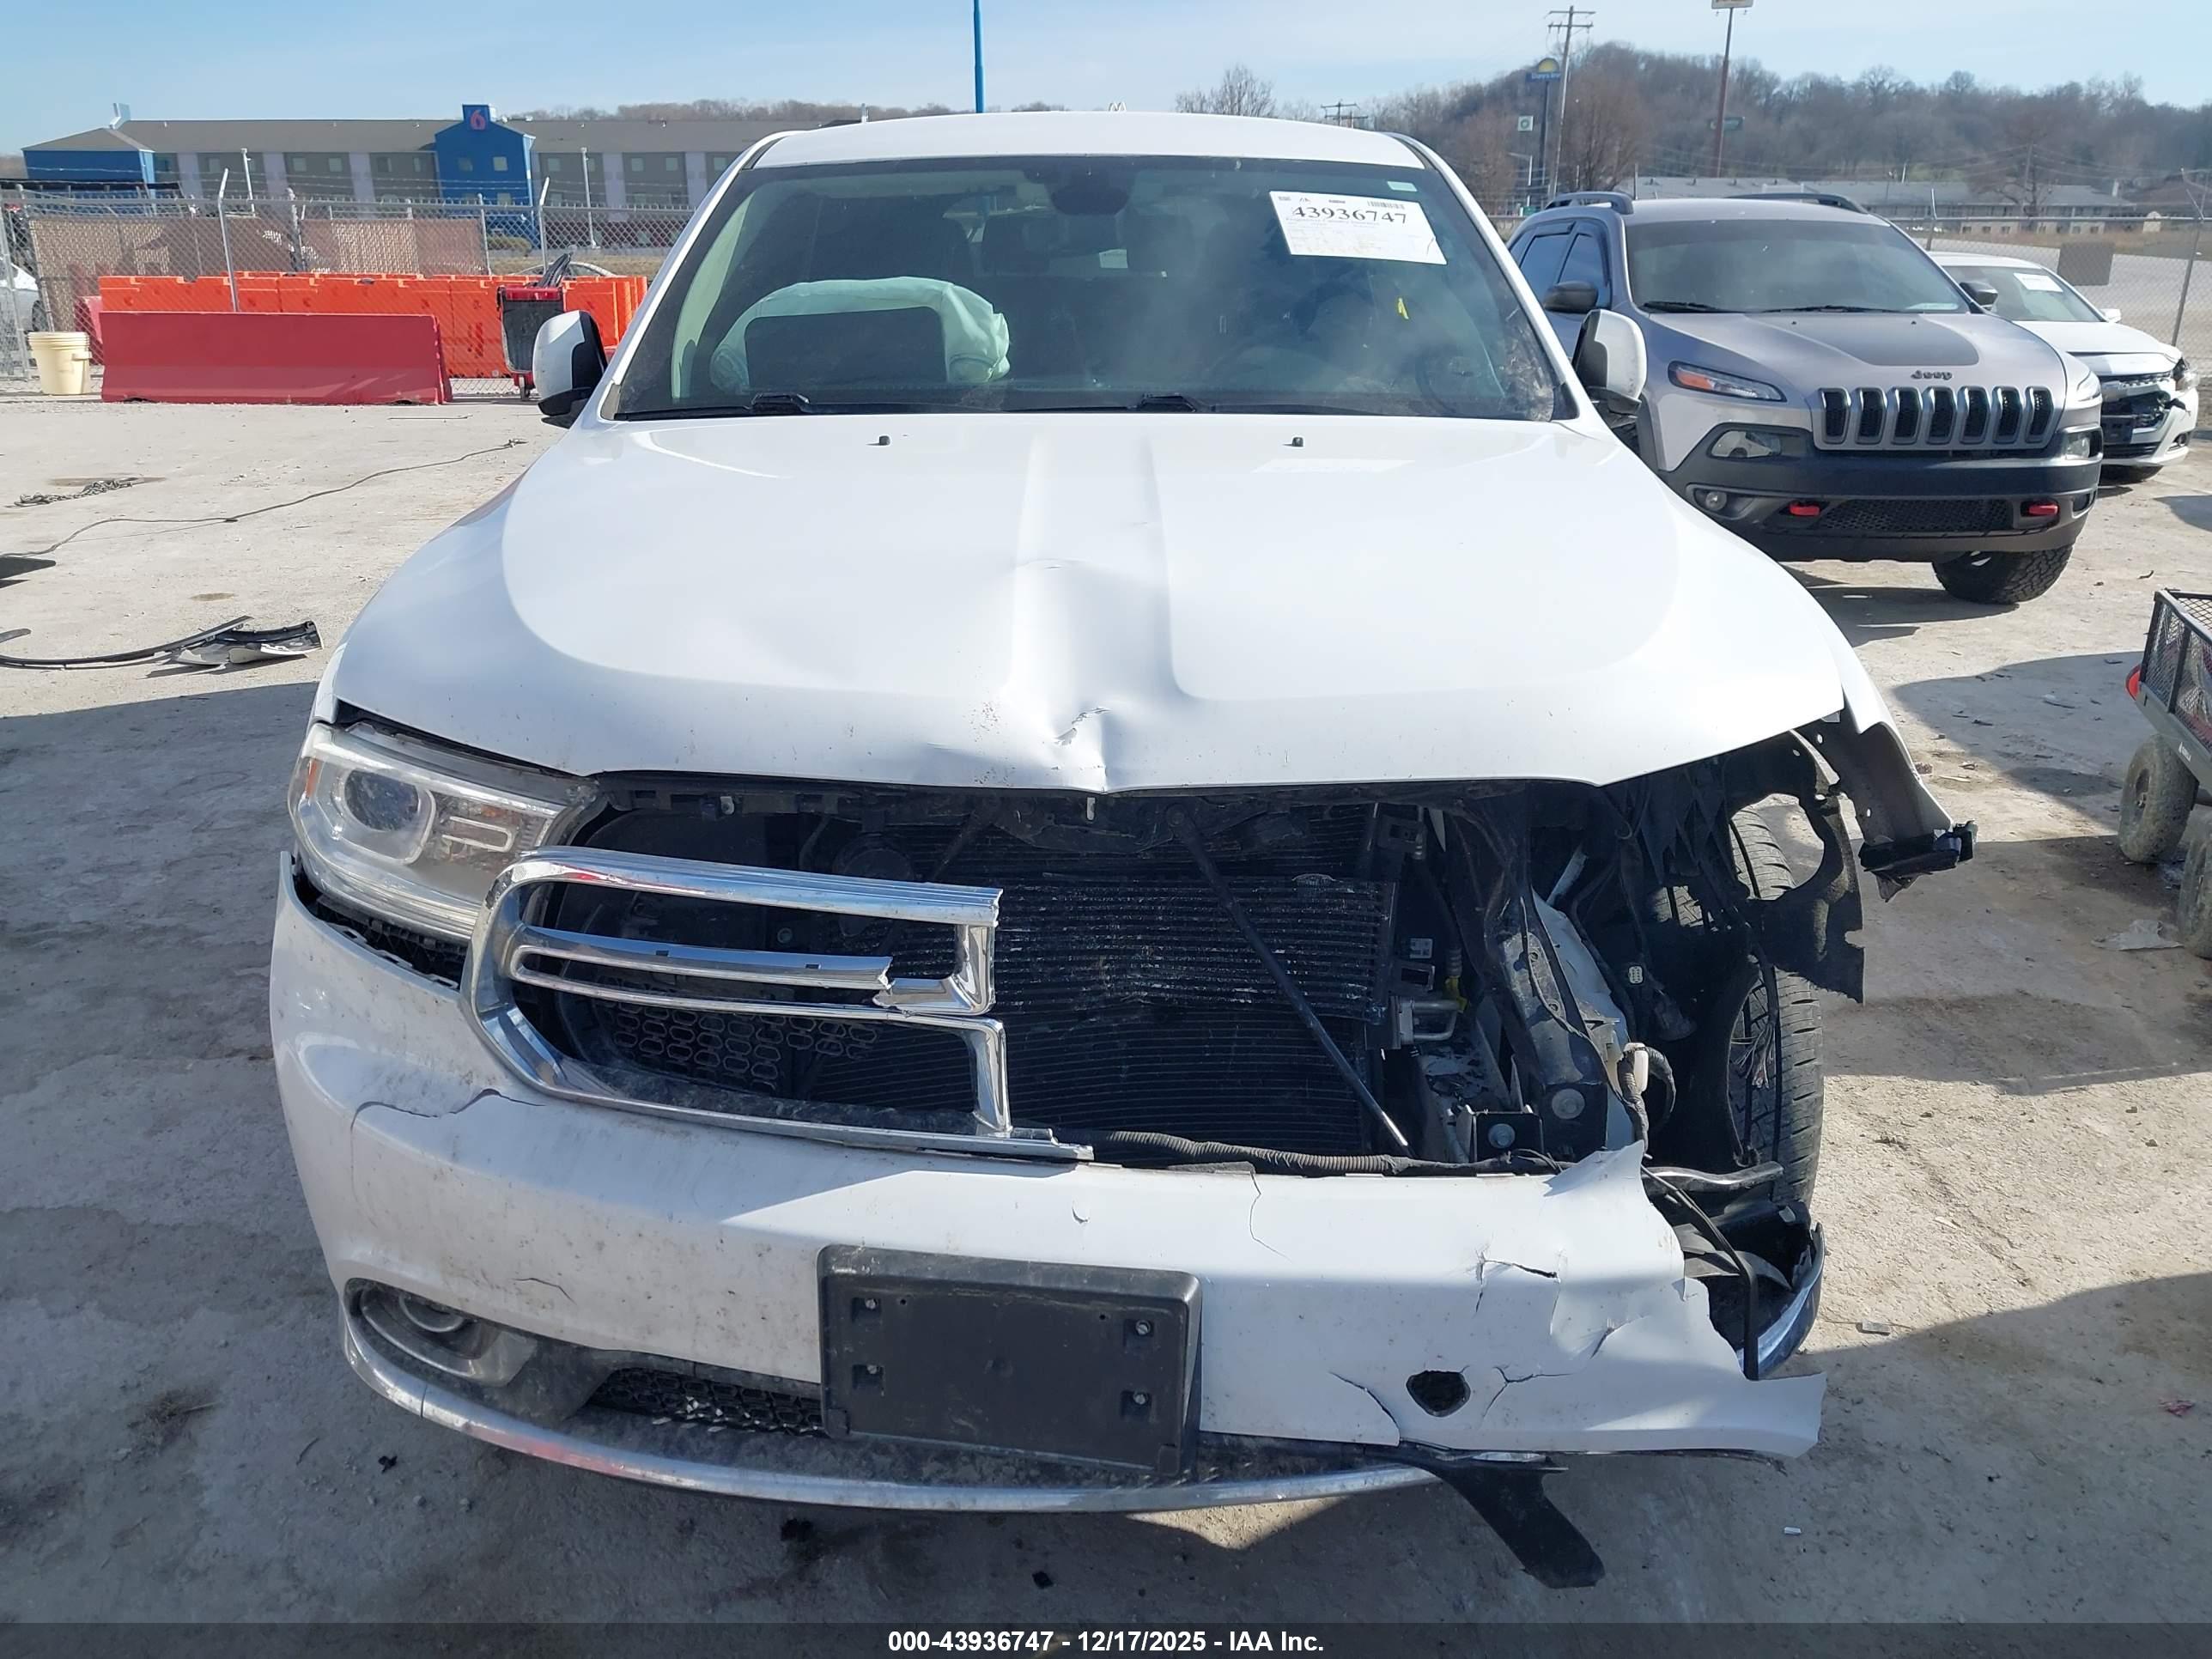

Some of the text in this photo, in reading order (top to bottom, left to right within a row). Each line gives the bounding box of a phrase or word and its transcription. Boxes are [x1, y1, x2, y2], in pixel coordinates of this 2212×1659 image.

[471, 109, 486, 131] 6
[1292, 205, 1407, 224] 43936747
[1911, 369, 1953, 380] Jeep
